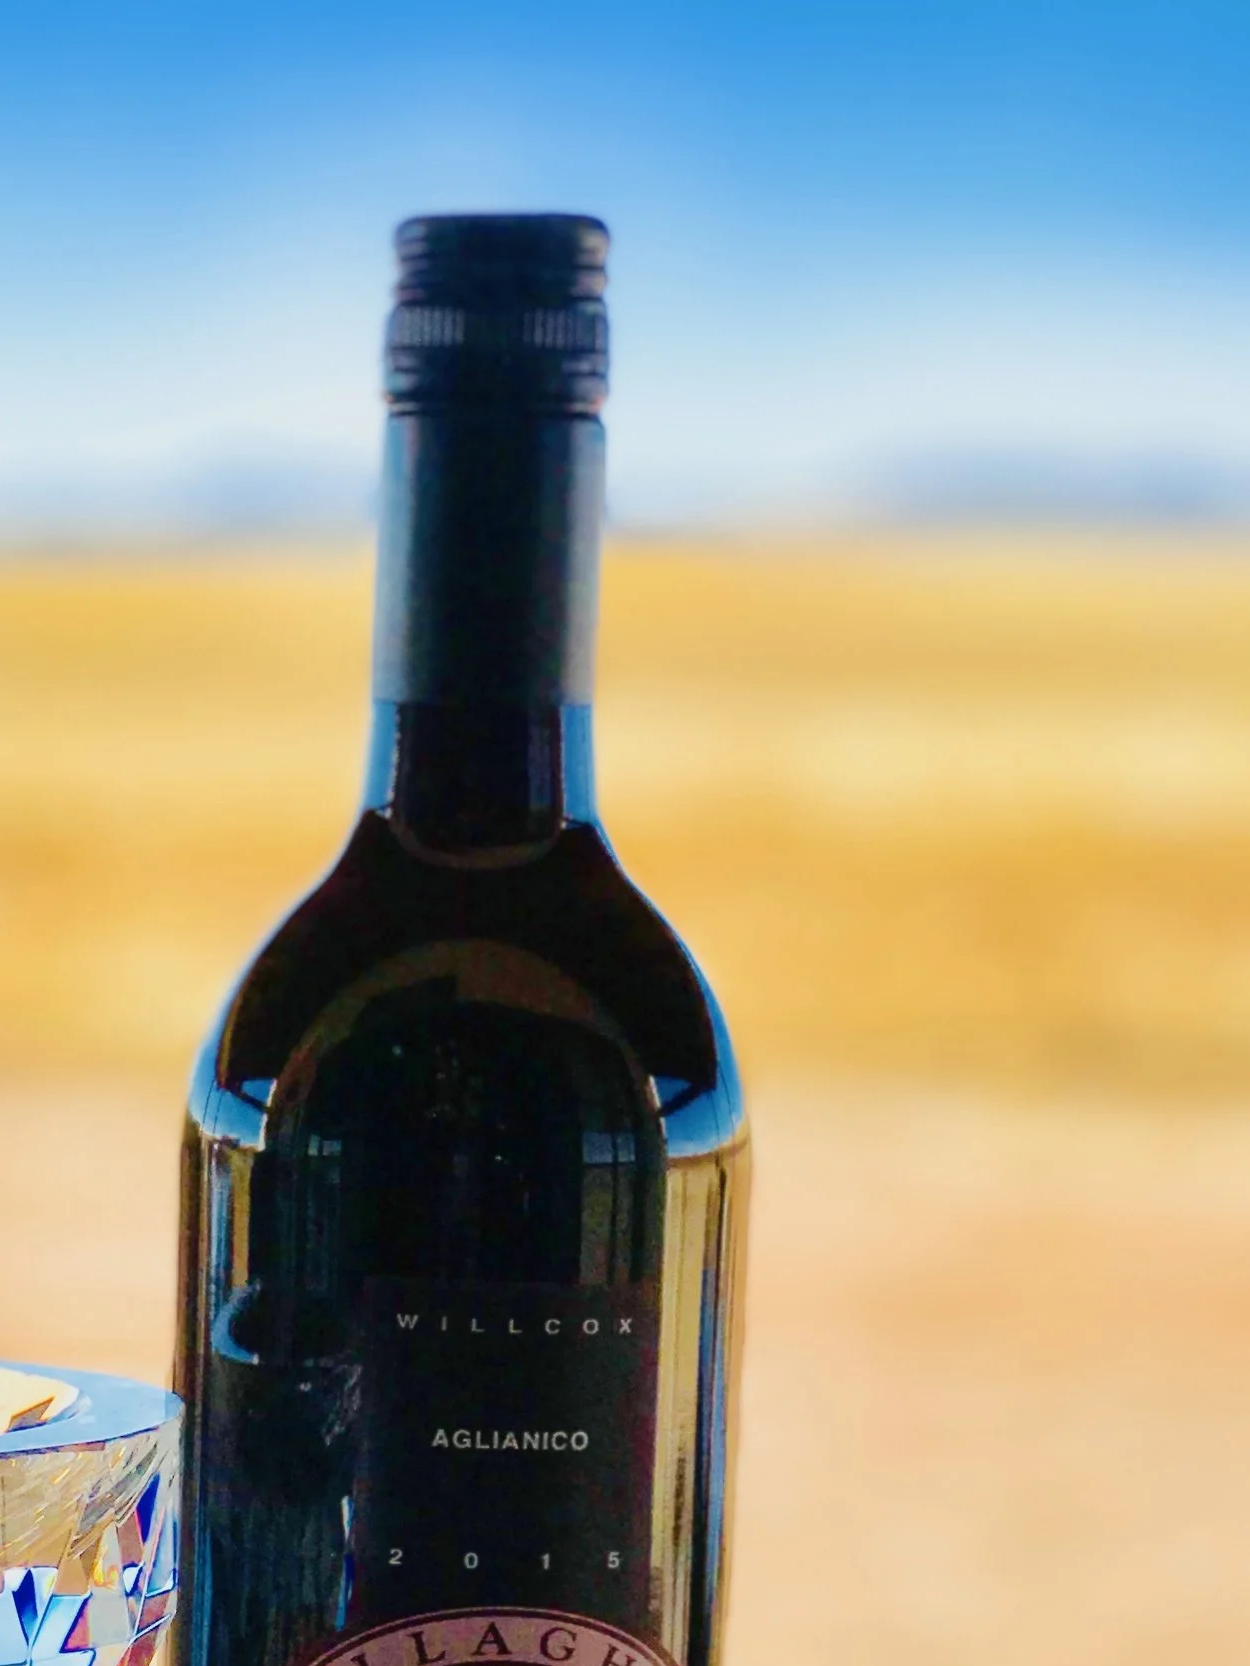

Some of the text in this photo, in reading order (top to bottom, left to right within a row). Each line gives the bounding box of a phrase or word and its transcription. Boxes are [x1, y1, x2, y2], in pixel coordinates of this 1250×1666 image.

[396, 1312, 632, 1335] WILLCOX
[431, 1428, 589, 1451] AGLIANICO
[389, 1548, 621, 1570] 2015
